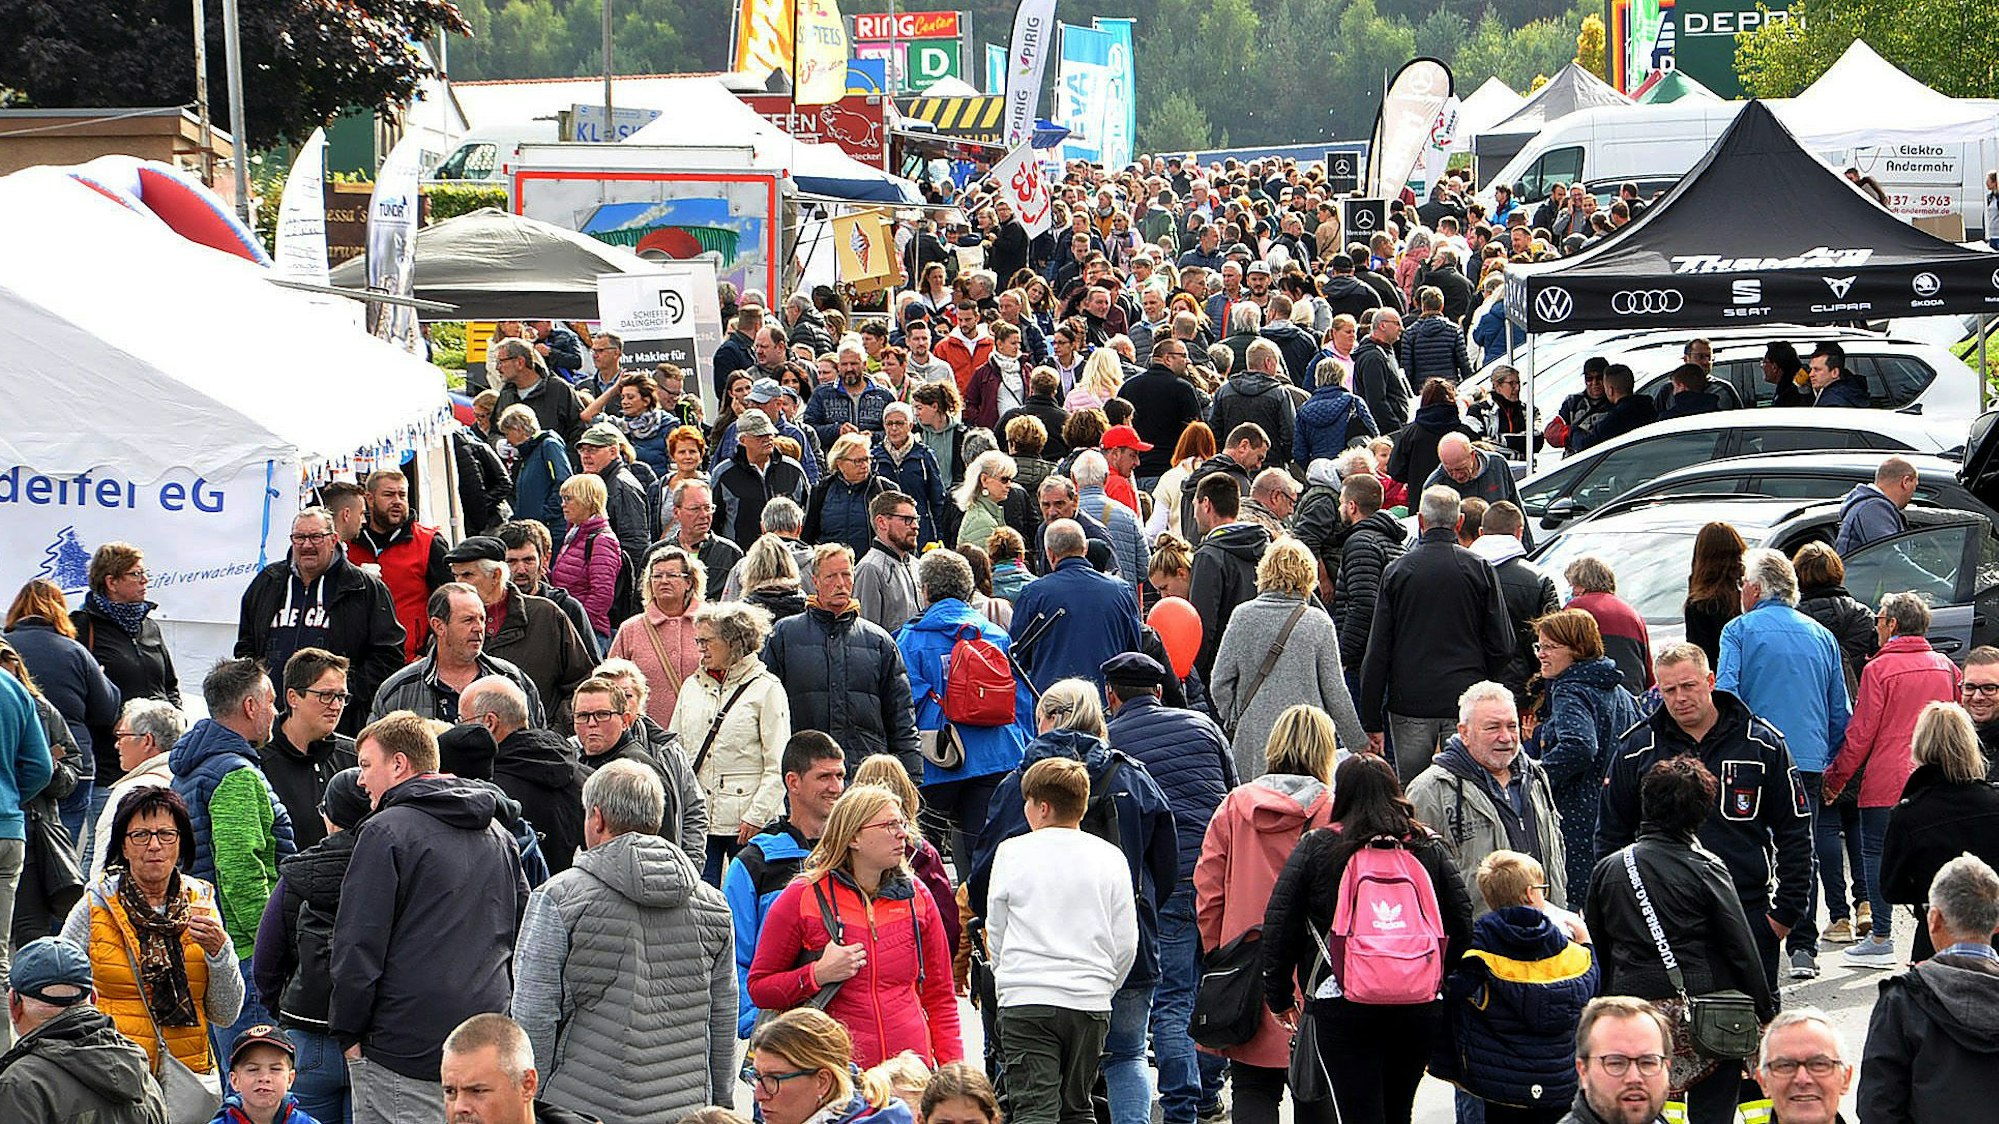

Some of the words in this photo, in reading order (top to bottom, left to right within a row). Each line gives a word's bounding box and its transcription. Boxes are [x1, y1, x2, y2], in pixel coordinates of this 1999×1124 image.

[858, 15, 914, 37] RING
[1023, 16, 1040, 58] PIRIG
[1013, 90, 1029, 131] PIRIG
[1899, 145, 1944, 156] Elektro
[1885, 161, 1955, 172] Andermahr
[1920, 195, 1951, 207] 5963
[1723, 306, 1772, 317] SEAT
[1810, 302, 1872, 313] CUPRA
[635, 351, 670, 363] Makler
[671, 349, 687, 361] für
